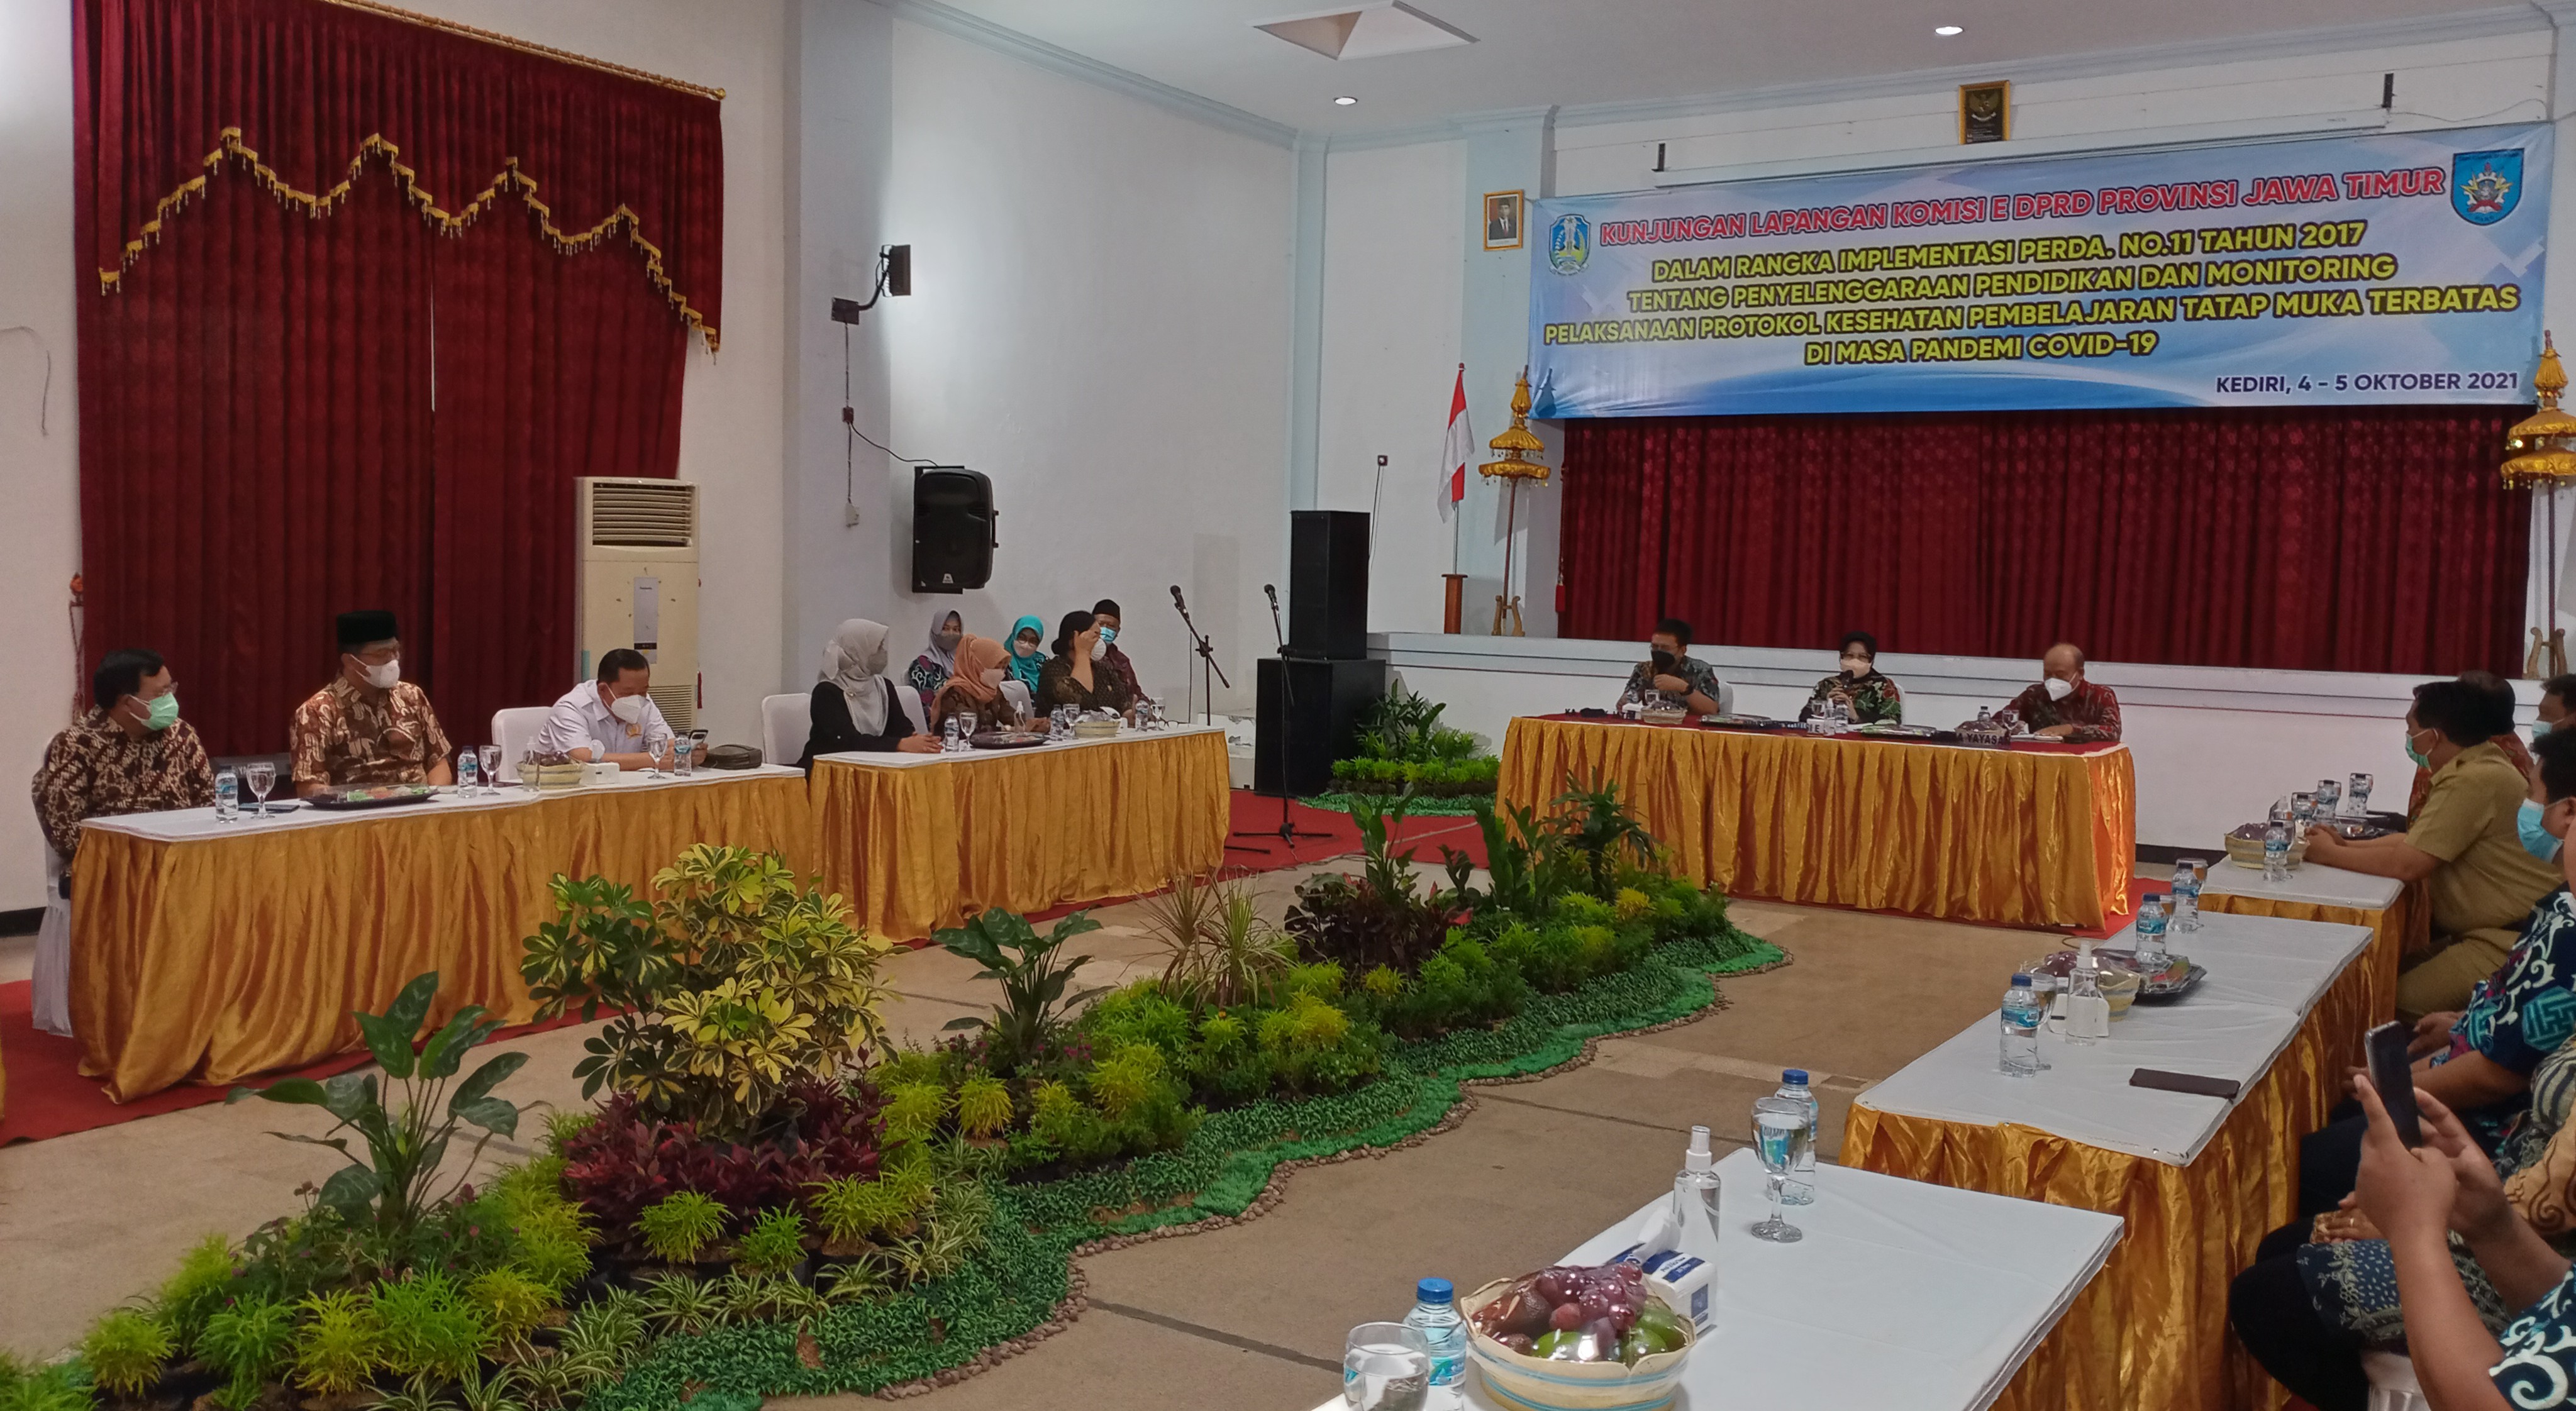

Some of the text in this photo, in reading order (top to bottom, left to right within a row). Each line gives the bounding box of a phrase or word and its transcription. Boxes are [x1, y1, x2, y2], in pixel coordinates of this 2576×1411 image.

[1601, 169, 2445, 244] KUNJUNGAN LAPANGAN KOMISI E DPRD PROVINSI JAWA TIMUR
[1653, 221, 2366, 282] DALAM RANGKA IMPLEMENTASI PERDA. NO.11 TAHUN 2017
[1627, 254, 2396, 313] TENTANG PENYELENGGARAAN PENDIDIKAN DAN MONITORING
[1544, 285, 2519, 345] PELAKSANAAN PROTOKOL KESEHATAN PEMBELAJARAN TATAP MUKA TERBATAS
[1806, 331, 2157, 364] DI MASA PANDEMI COVID-19
[2216, 375, 2291, 394] KEDIRI,
[2297, 375, 2311, 391] 4
[2334, 375, 2347, 391] 5
[2354, 374, 2461, 390] OKTOBER
[2467, 372, 2518, 389] 2021
